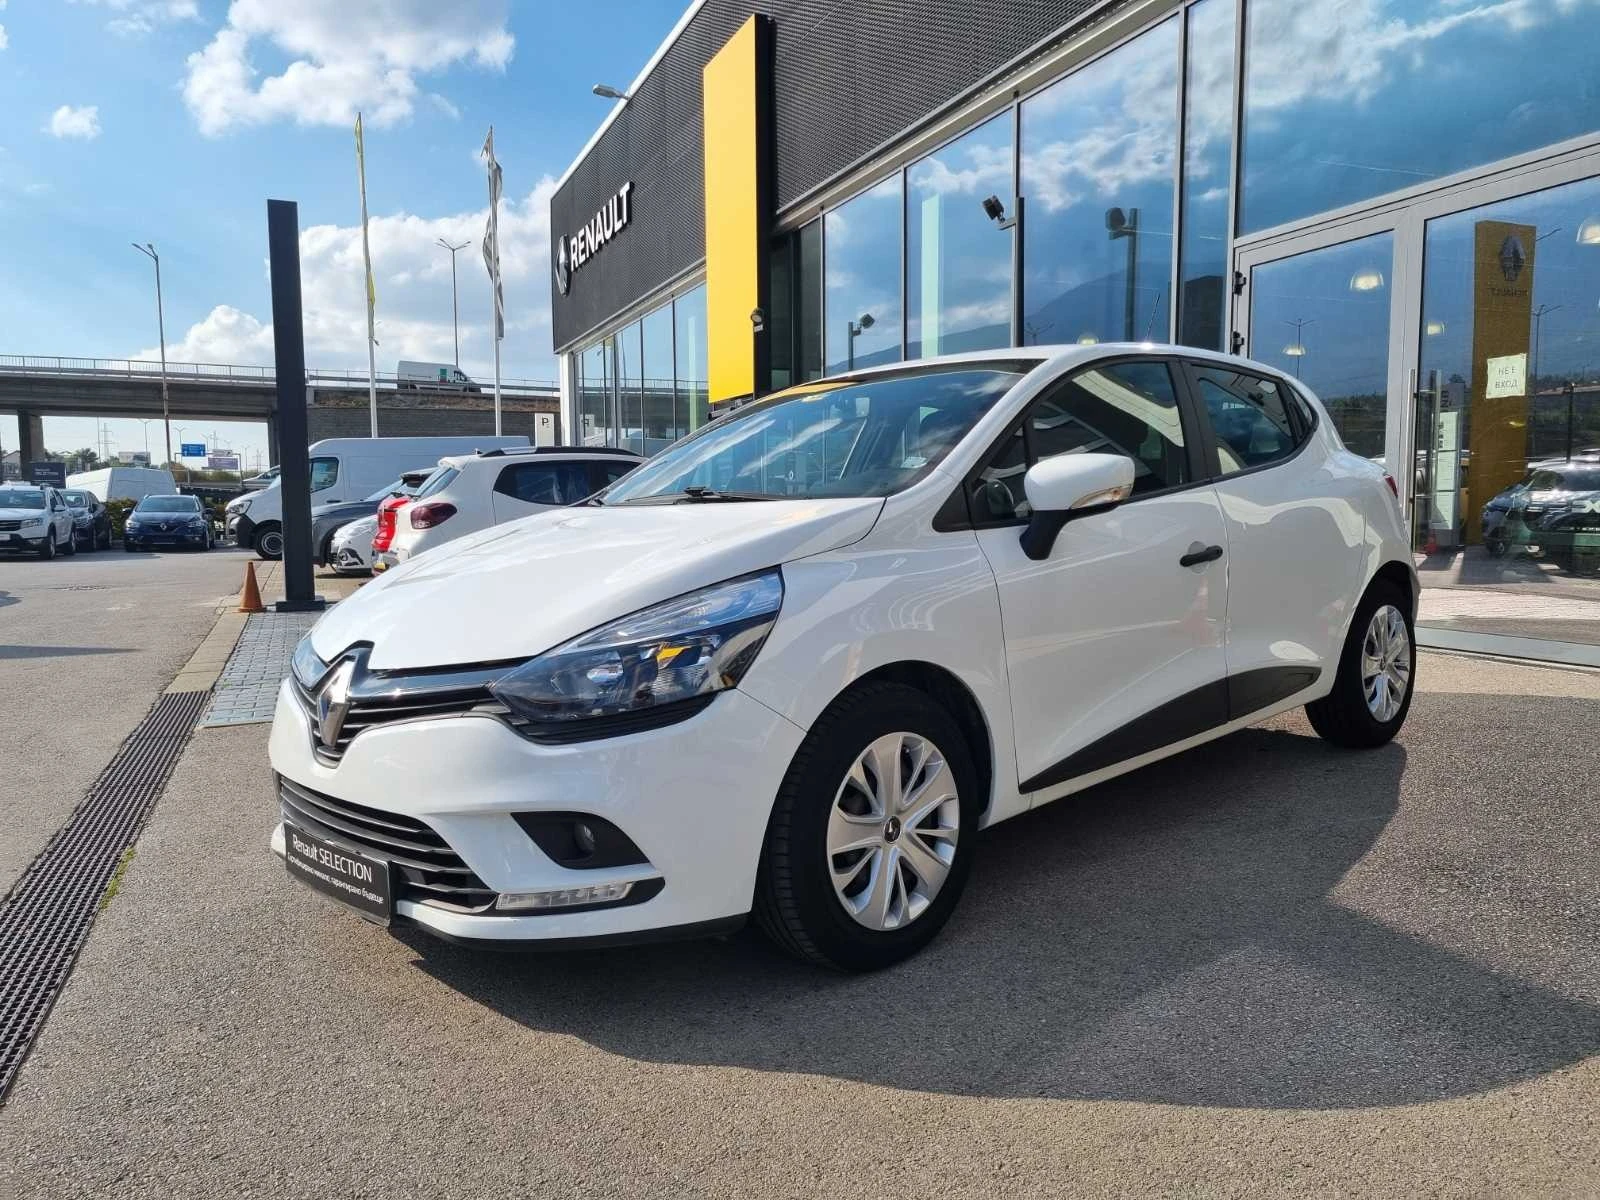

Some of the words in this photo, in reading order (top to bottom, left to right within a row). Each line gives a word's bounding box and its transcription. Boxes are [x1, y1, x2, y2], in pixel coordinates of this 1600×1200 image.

[570, 181, 631, 272] RENAULT
[541, 416, 549, 426] P
[292, 833, 318, 862] Renault
[319, 847, 373, 883] SELECTION
[361, 887, 384, 905] бъдеще
